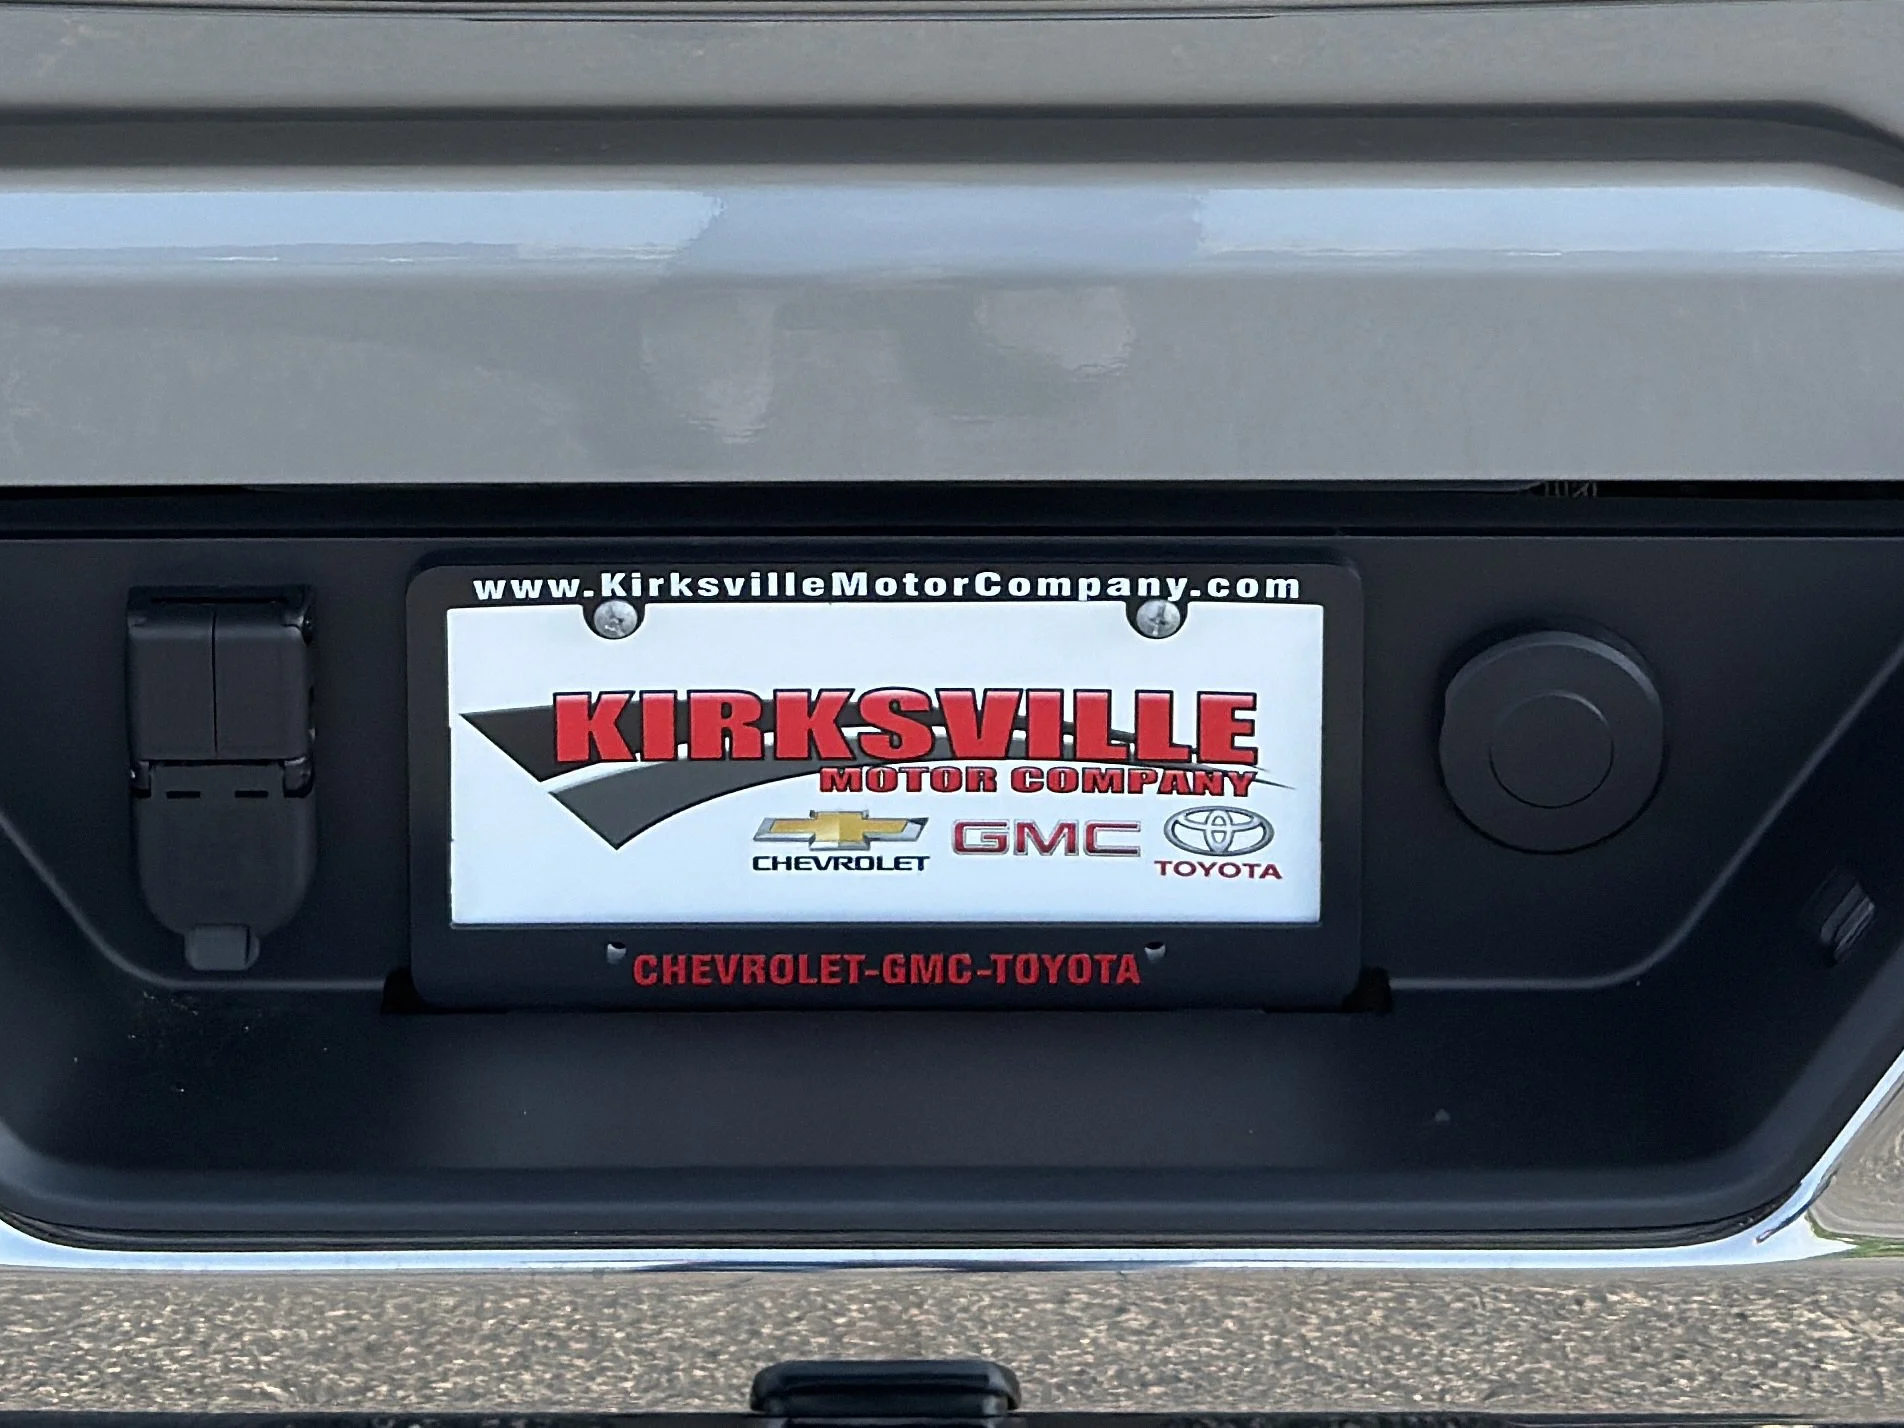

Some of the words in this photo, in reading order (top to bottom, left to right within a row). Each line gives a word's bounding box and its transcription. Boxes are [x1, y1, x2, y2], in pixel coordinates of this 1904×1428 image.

[472, 571, 1300, 602] www.KirksvilleMotorCompany.com
[550, 686, 1260, 766] KIRKSVILLE
[818, 766, 998, 794] MOTOR
[1009, 766, 1259, 798] COMPANY
[950, 817, 1143, 858] GMC
[751, 854, 931, 873] CHEVROLET
[1153, 859, 1284, 881] TOYOTA
[632, 952, 1141, 986] CHEVROLET-GMC-TOYOTA
